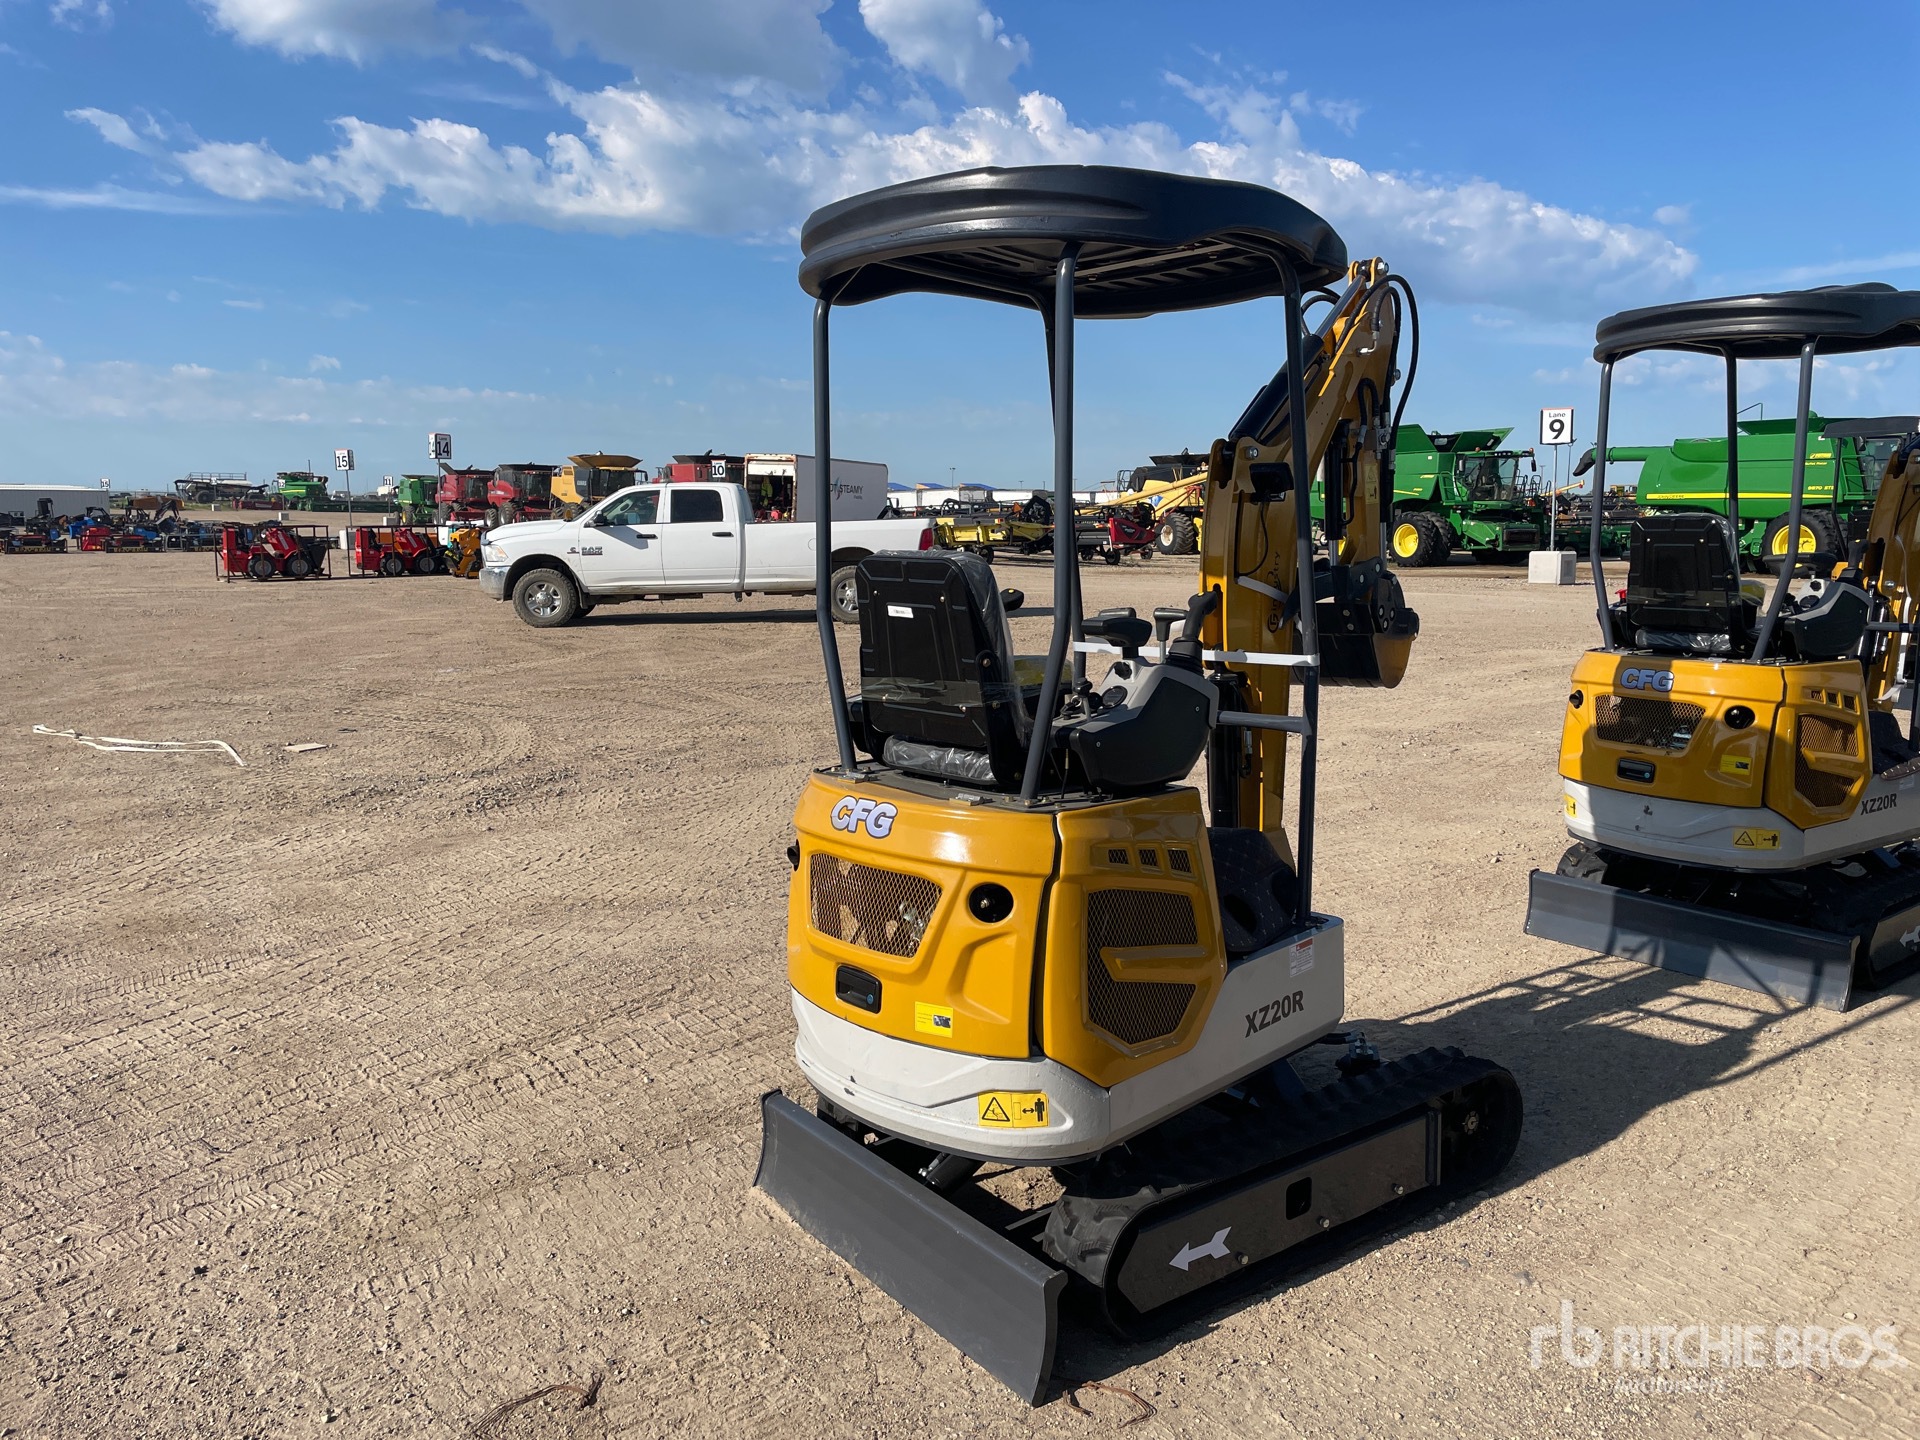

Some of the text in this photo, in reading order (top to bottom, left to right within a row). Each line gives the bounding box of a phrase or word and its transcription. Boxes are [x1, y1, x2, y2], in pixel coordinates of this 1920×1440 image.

[1549, 418, 1565, 440] 9
[436, 441, 450, 457] 14
[336, 455, 348, 468] 15
[711, 465, 725, 476] 10
[839, 484, 864, 494] STEAMY
[1621, 667, 1675, 693] CFG
[1860, 793, 1897, 816] XZ20R
[830, 795, 898, 839] CFG
[1245, 990, 1304, 1038] XZ20R
